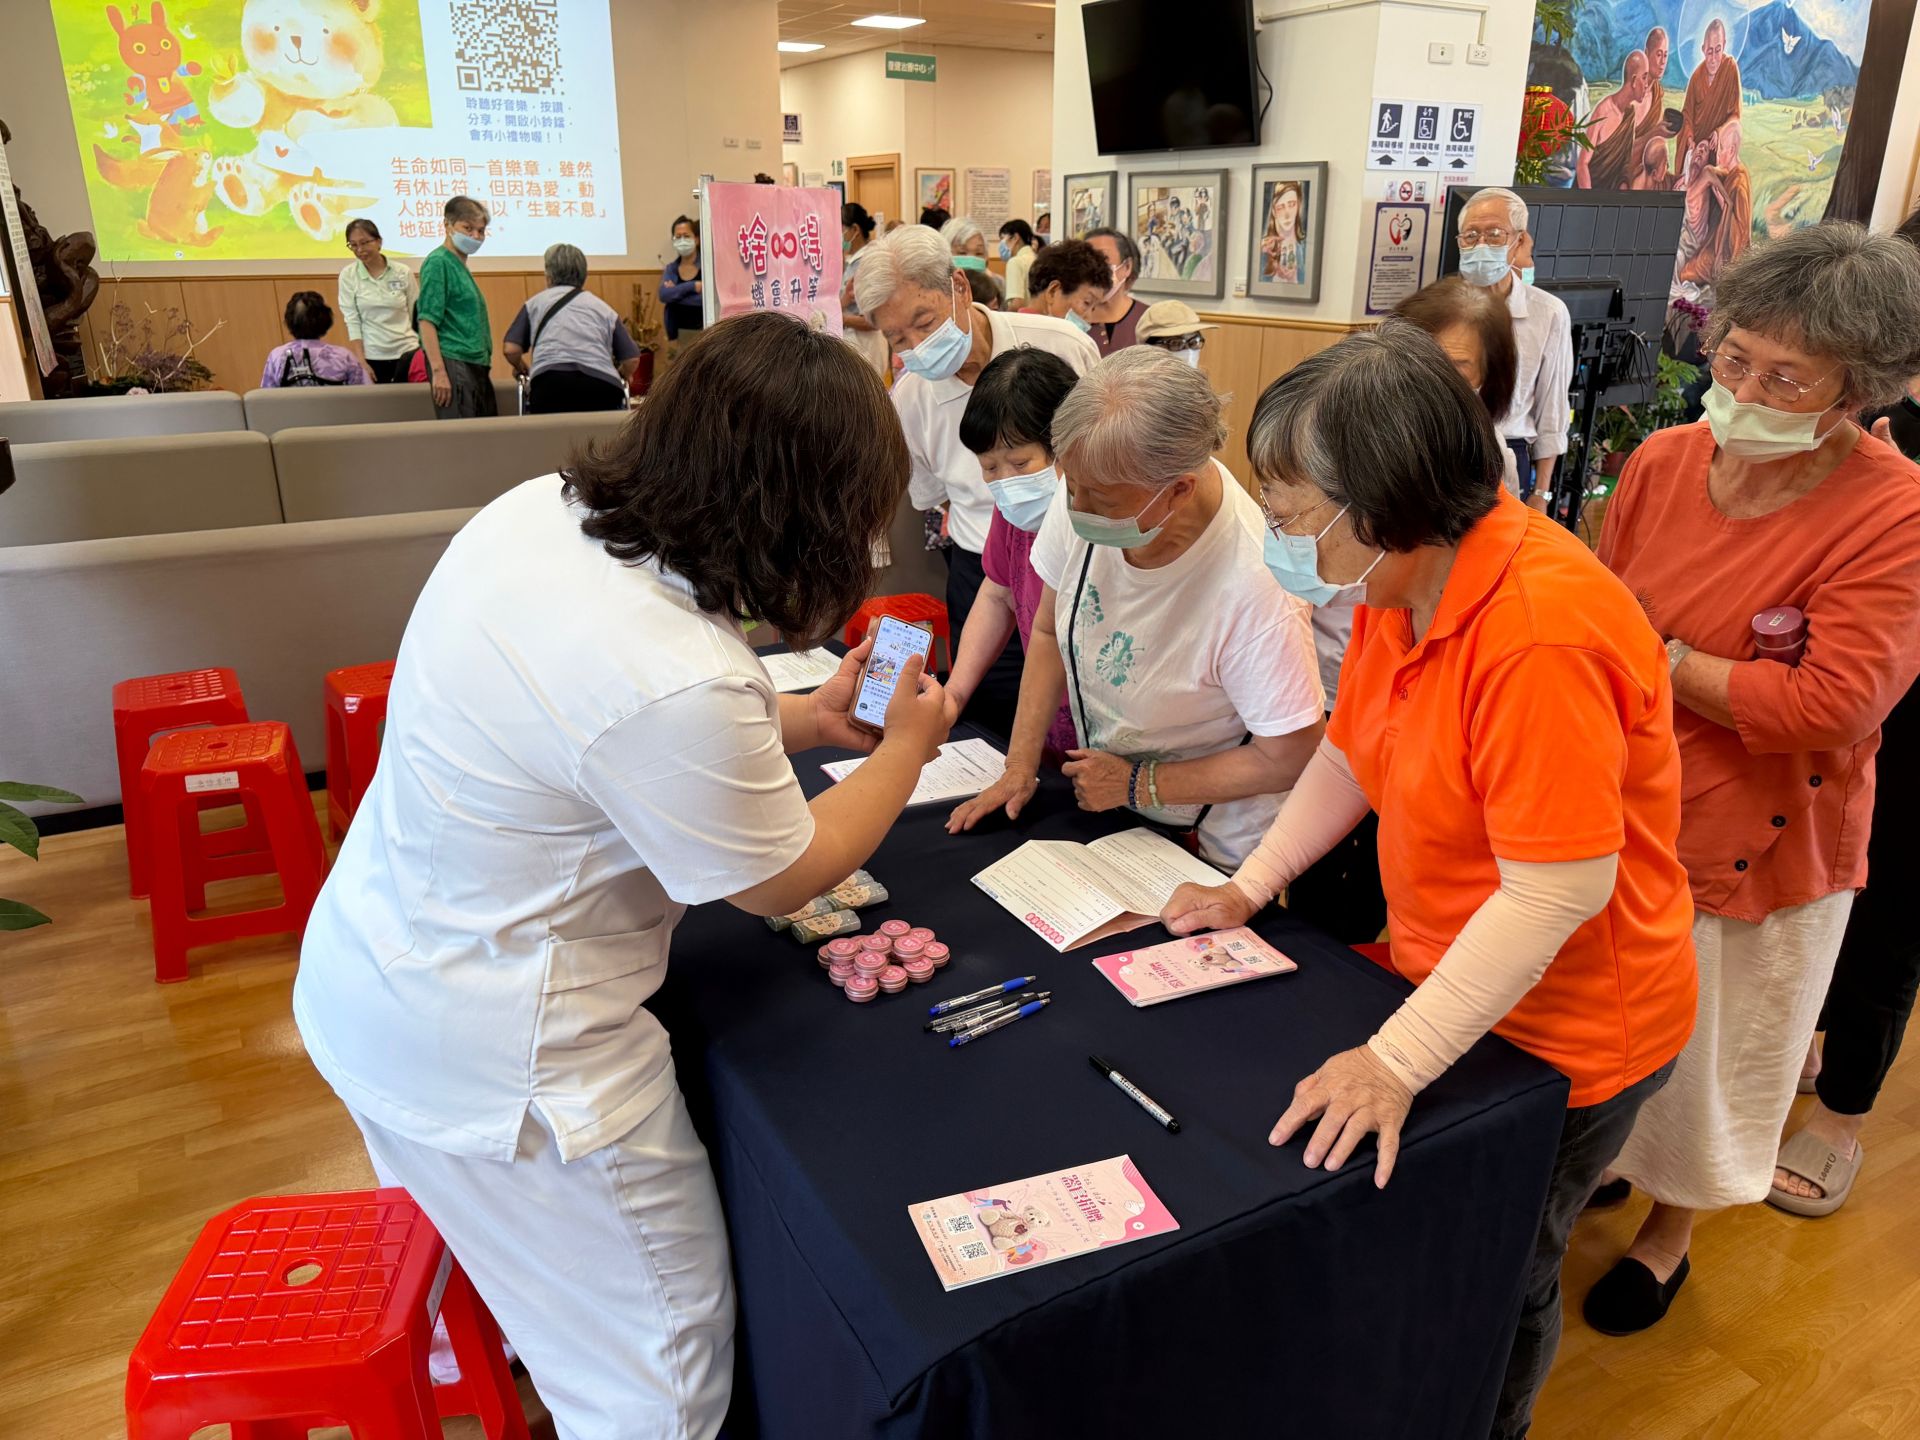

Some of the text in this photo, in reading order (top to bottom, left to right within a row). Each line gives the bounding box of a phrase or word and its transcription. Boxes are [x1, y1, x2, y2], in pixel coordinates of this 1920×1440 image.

[391, 157, 593, 178] 生命如同一首樂章，雖然
